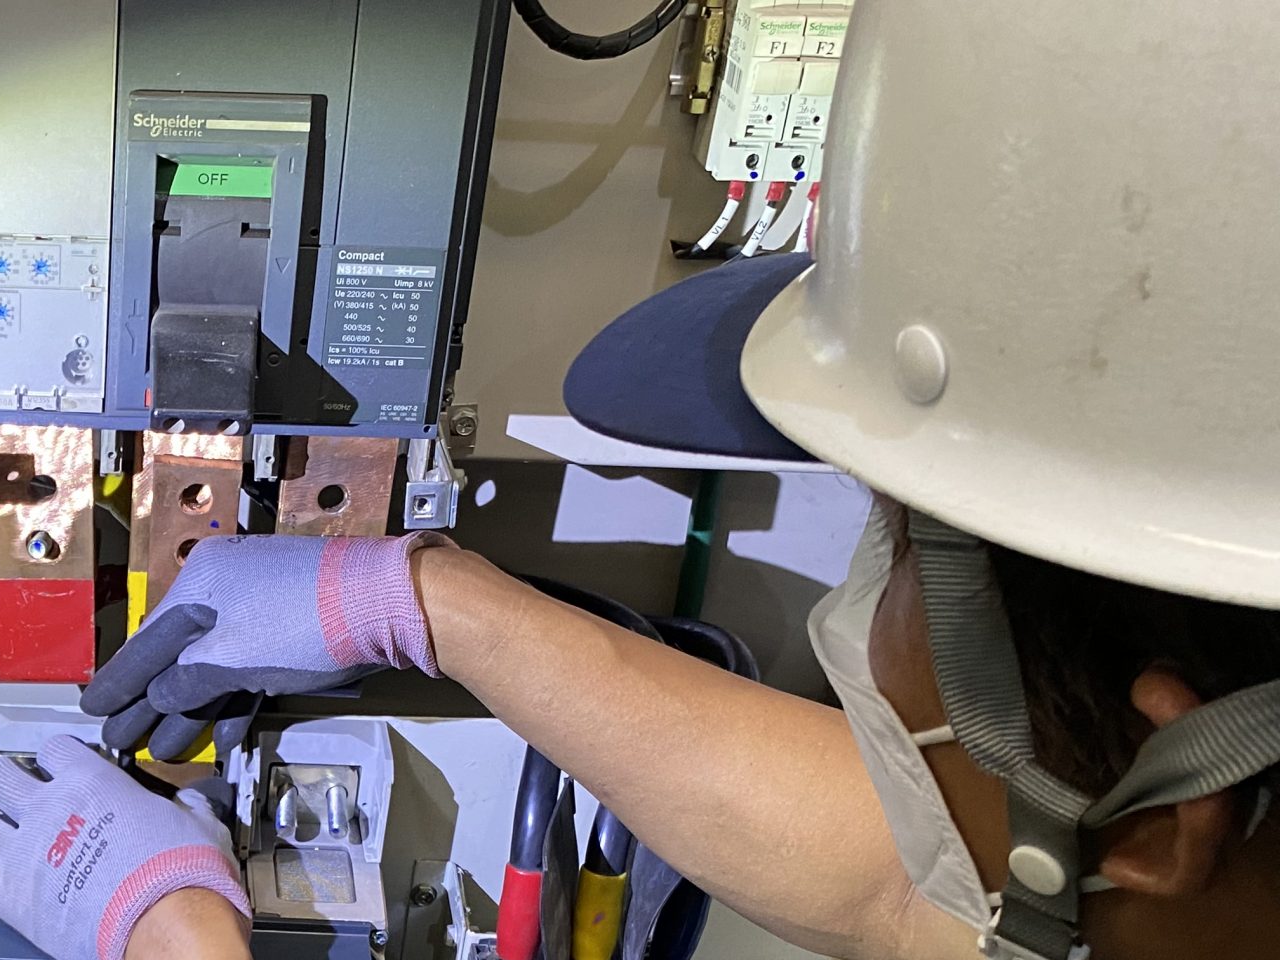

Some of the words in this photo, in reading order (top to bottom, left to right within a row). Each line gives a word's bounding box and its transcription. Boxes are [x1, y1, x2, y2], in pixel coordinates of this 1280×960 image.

[760, 22, 801, 31] Schneider
[770, 41, 787, 54] F1
[816, 41, 835, 55] F2
[133, 113, 205, 130] Schneider
[198, 173, 229, 186] OFF
[751, 220, 768, 241] VL2
[338, 250, 385, 262] Compact
[337, 265, 374, 275] NS1250
[375, 266, 383, 275] N
[336, 278, 344, 286] Ui
[394, 280, 414, 288] Uimp
[335, 290, 345, 298] Ue
[347, 291, 375, 299] 220/240
[345, 302, 374, 310] 380/415
[391, 302, 406, 310] (kA)
[372, 358, 379, 366] 1s
[47, 814, 86, 868] 3M
[58, 842, 92, 904] Comfort
[88, 812, 115, 840] Grip
[74, 839, 108, 890] Gloves
